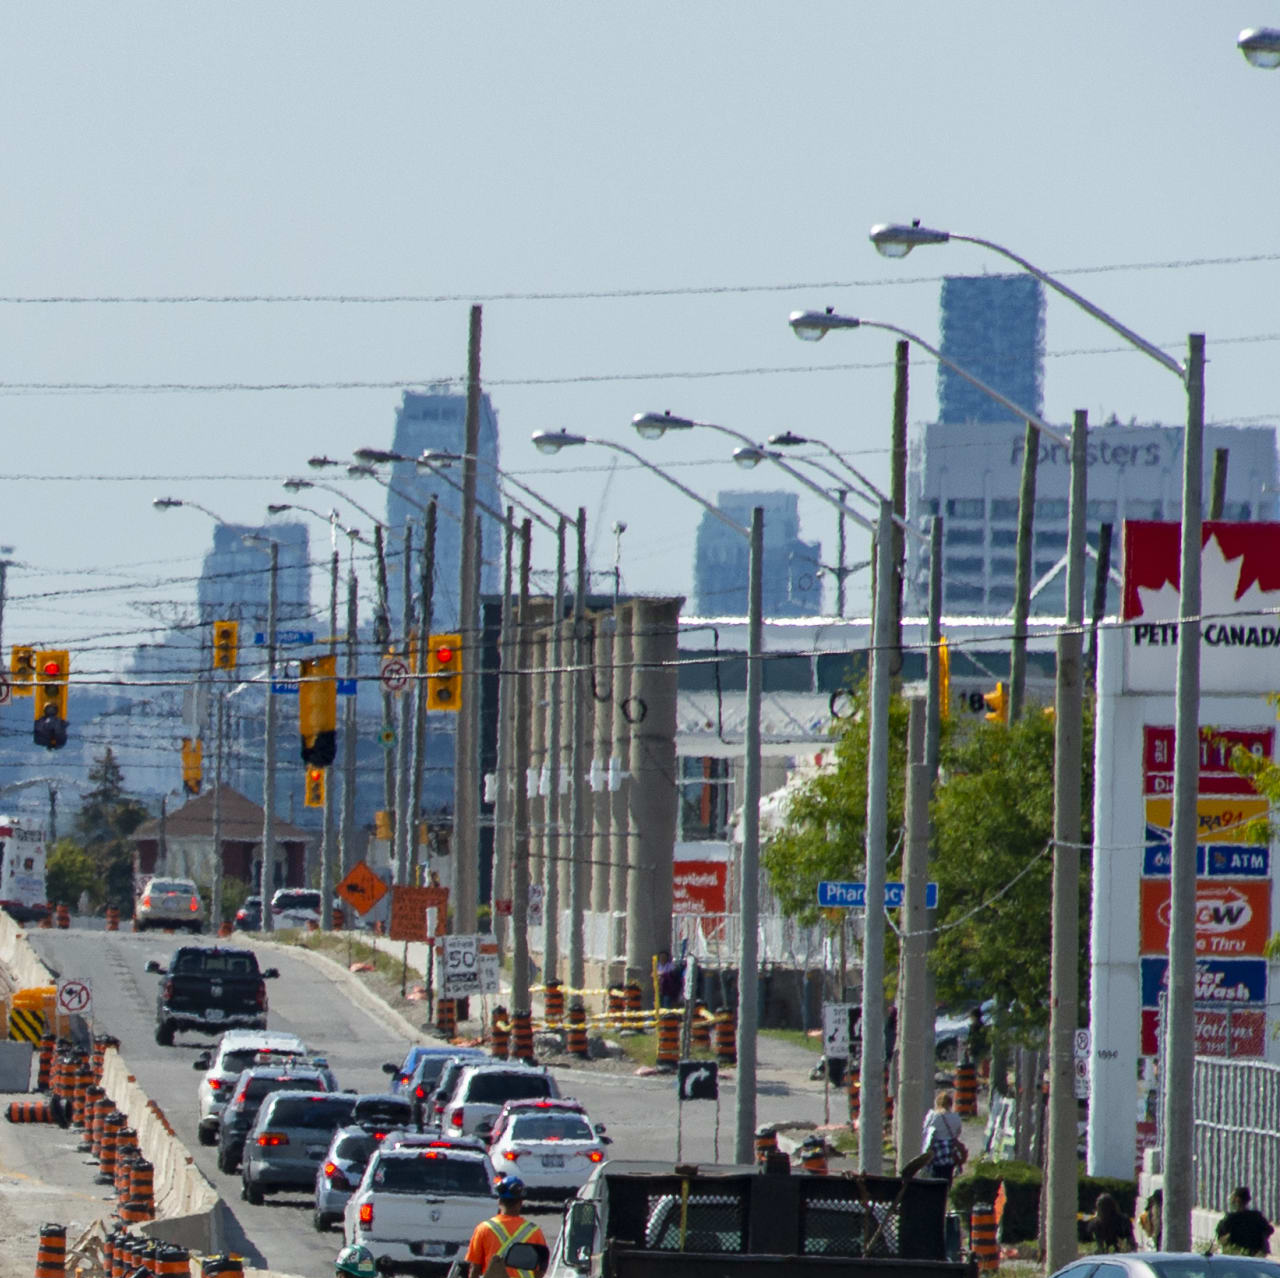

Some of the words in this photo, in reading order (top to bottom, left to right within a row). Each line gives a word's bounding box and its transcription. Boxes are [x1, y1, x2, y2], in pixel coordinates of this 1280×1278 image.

[1230, 854, 1264, 868] ATM
[1211, 936, 1247, 950] Thru
[449, 950, 475, 968] 50
[1195, 983, 1250, 1001] Wash
